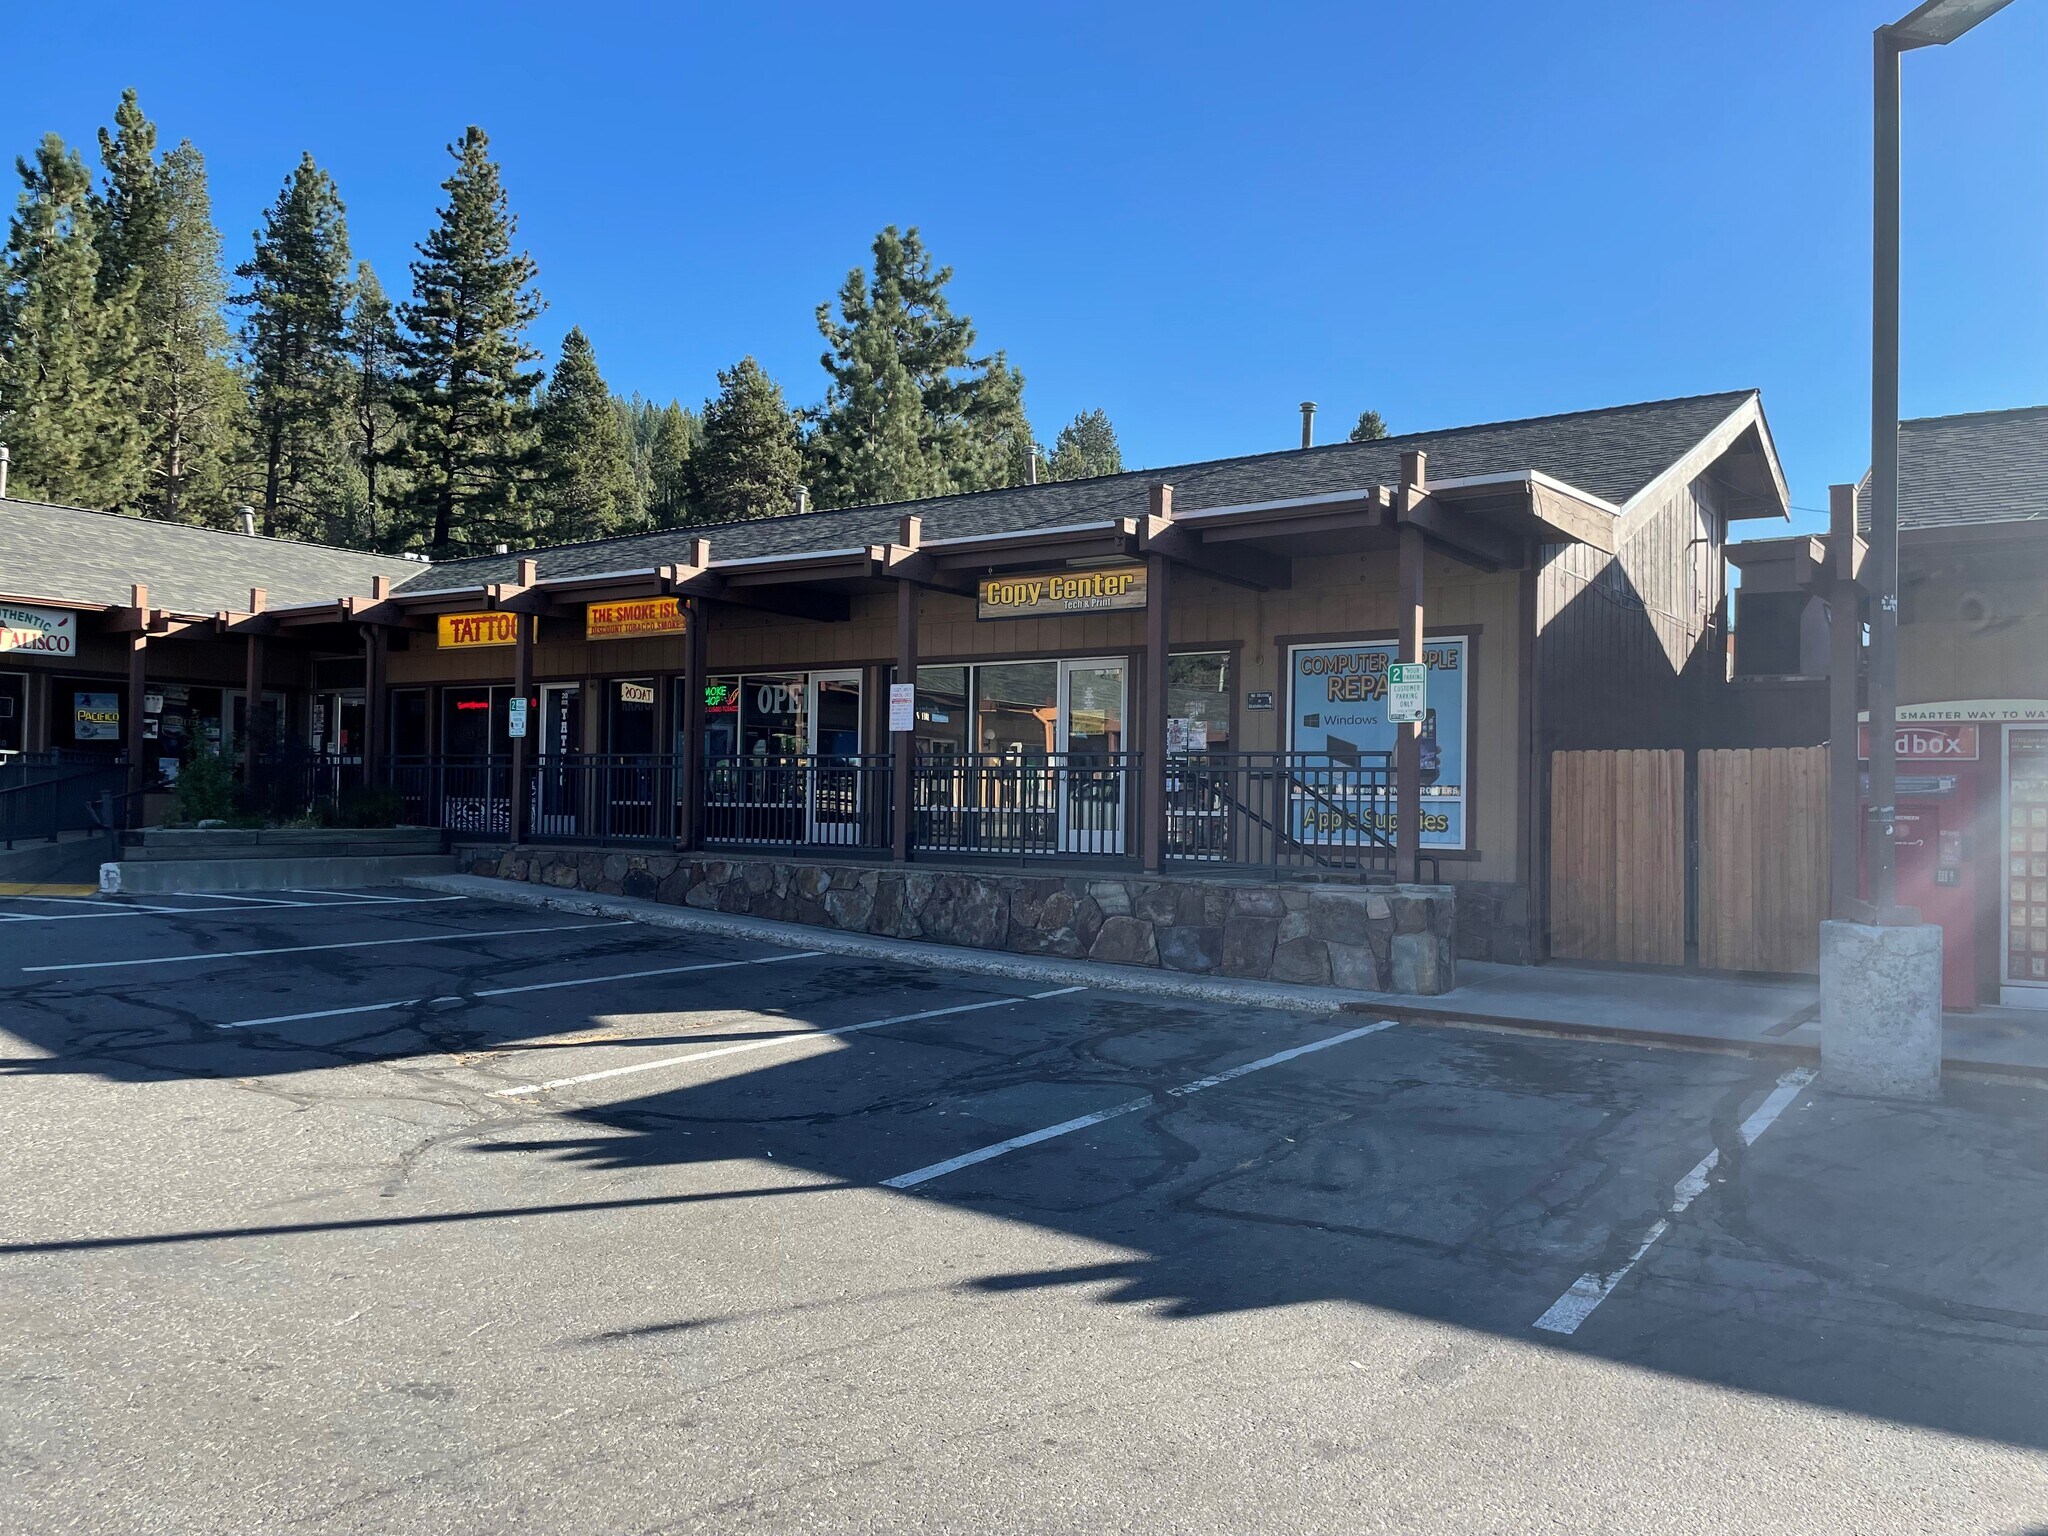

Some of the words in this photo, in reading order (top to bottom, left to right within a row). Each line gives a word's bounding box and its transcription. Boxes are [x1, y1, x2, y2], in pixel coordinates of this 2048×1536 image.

[986, 582, 1043, 607] Copy
[1048, 573, 1134, 600] Center
[1064, 600, 1083, 610] Tech
[1084, 599, 1090, 608] &
[1091, 598, 1112, 608] Print
[0, 608, 52, 632] THENTIC
[592, 608, 612, 623] THE
[616, 604, 656, 622] SMOKE
[660, 602, 681, 618] ISL
[591, 624, 623, 635] DISCOUNT
[0, 628, 70, 652] ALISCO
[1300, 652, 1389, 676] COMPUTER
[1421, 650, 1459, 670] PLE
[1393, 668, 1401, 681] 2
[705, 686, 727, 696] MOKE
[1327, 675, 1389, 702] REPA
[511, 701, 516, 710] 2
[77, 710, 120, 721] PACIFICO
[1324, 714, 1378, 725] Windows
[1900, 711, 1961, 720] SMARTER
[1967, 711, 1996, 719] WAY
[2002, 711, 2019, 719] TO
[1895, 734, 1962, 754] dbox
[1304, 807, 1358, 832] Appe
[1363, 807, 1449, 834] Supies
